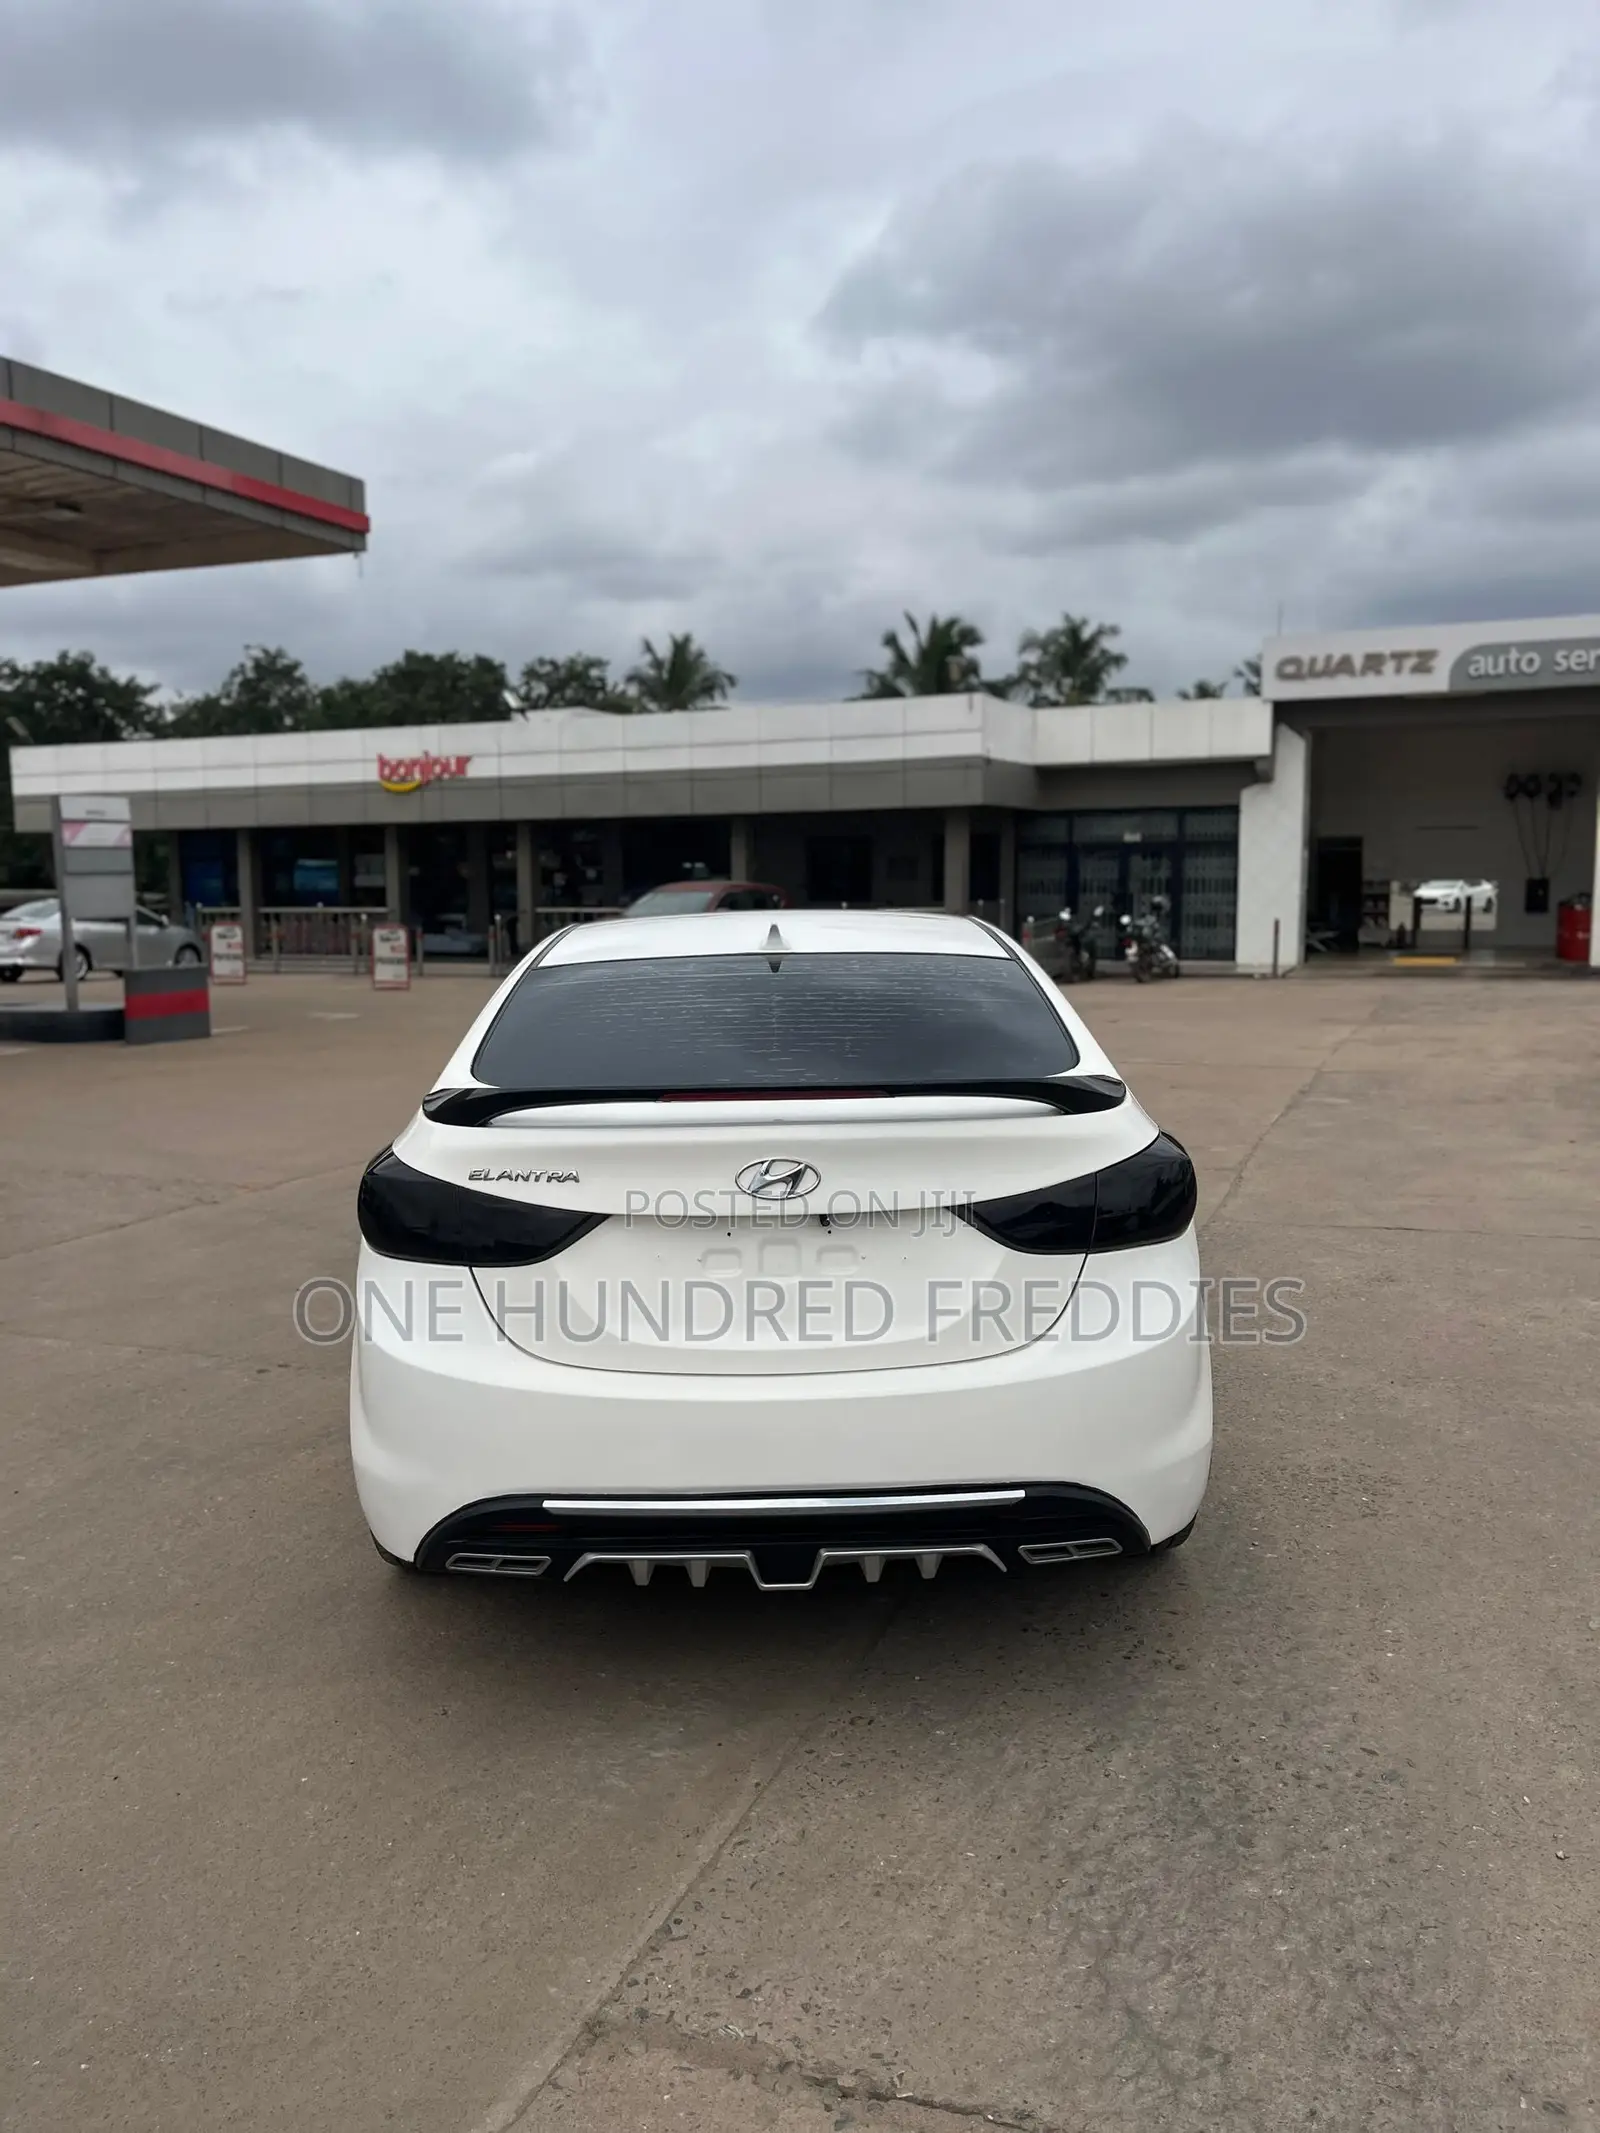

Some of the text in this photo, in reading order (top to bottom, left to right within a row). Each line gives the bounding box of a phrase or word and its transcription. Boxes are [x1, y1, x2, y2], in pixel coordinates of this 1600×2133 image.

[1276, 650, 1437, 681] QUARTZ
[1468, 647, 1541, 677] auto
[377, 750, 472, 785] bonjour
[468, 1168, 580, 1183] ELANTRA
